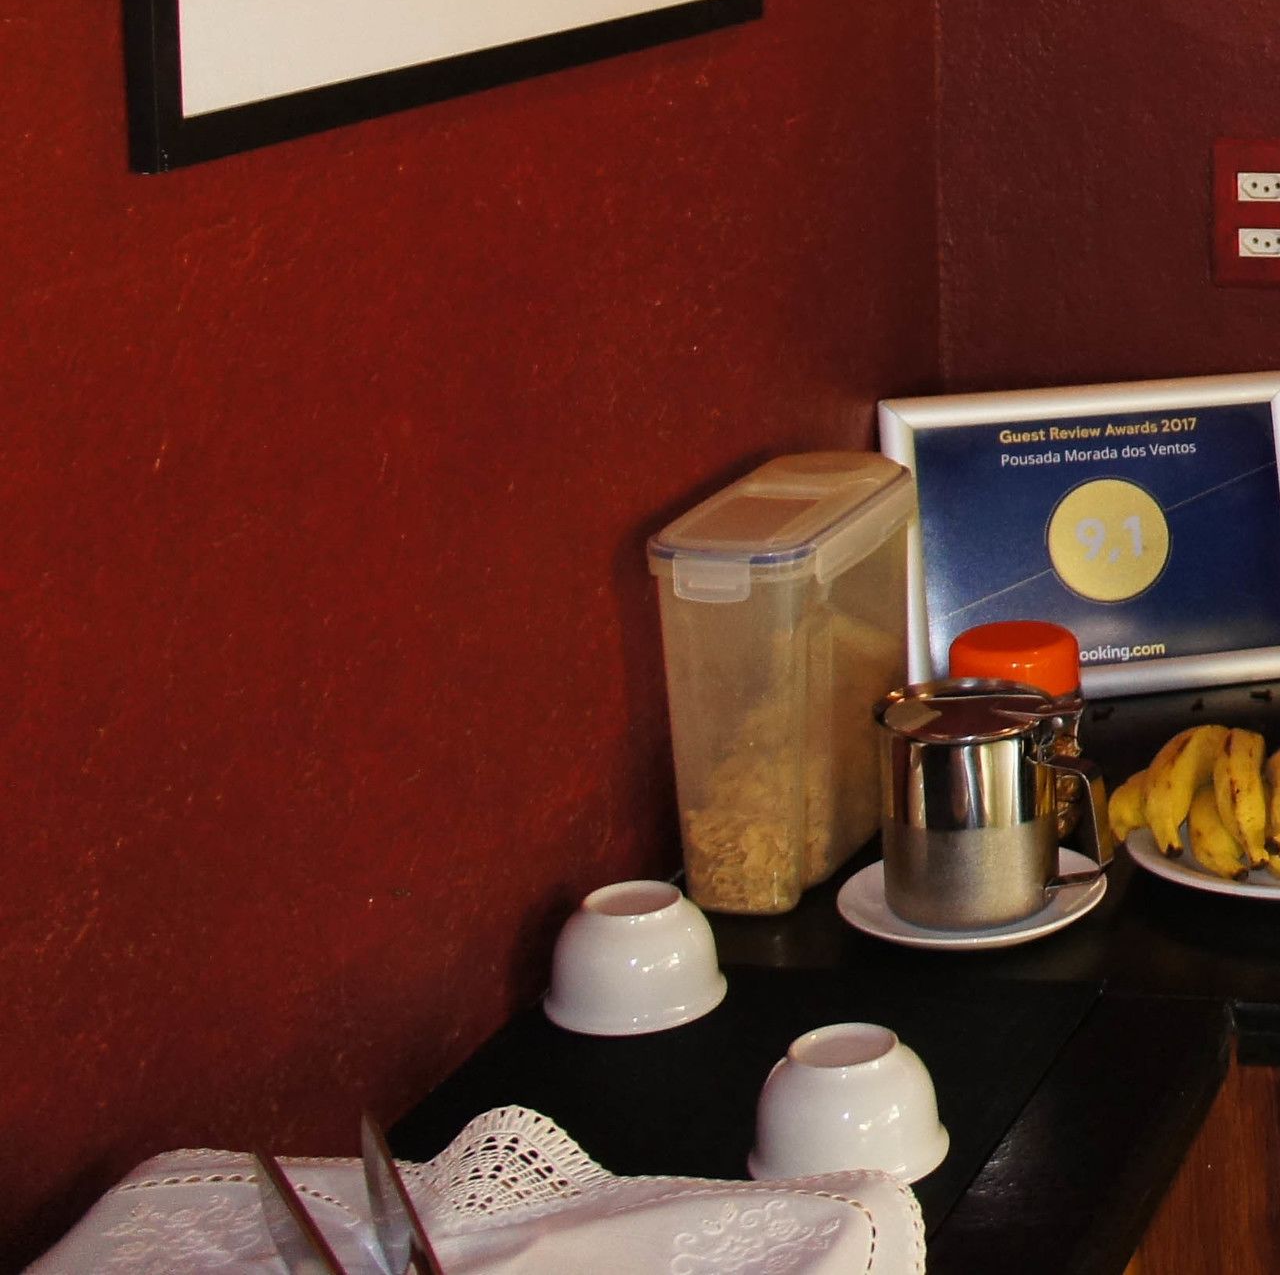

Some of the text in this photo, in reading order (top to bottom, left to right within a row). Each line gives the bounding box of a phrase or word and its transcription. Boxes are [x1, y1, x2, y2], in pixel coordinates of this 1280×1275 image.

[1000, 417, 1197, 444] Guest Review Awards 2017
[1001, 441, 1197, 467] Pousada Morada dos Ventos
[1075, 514, 1144, 566] 9,1
[1080, 643, 1166, 661] ooking.com
